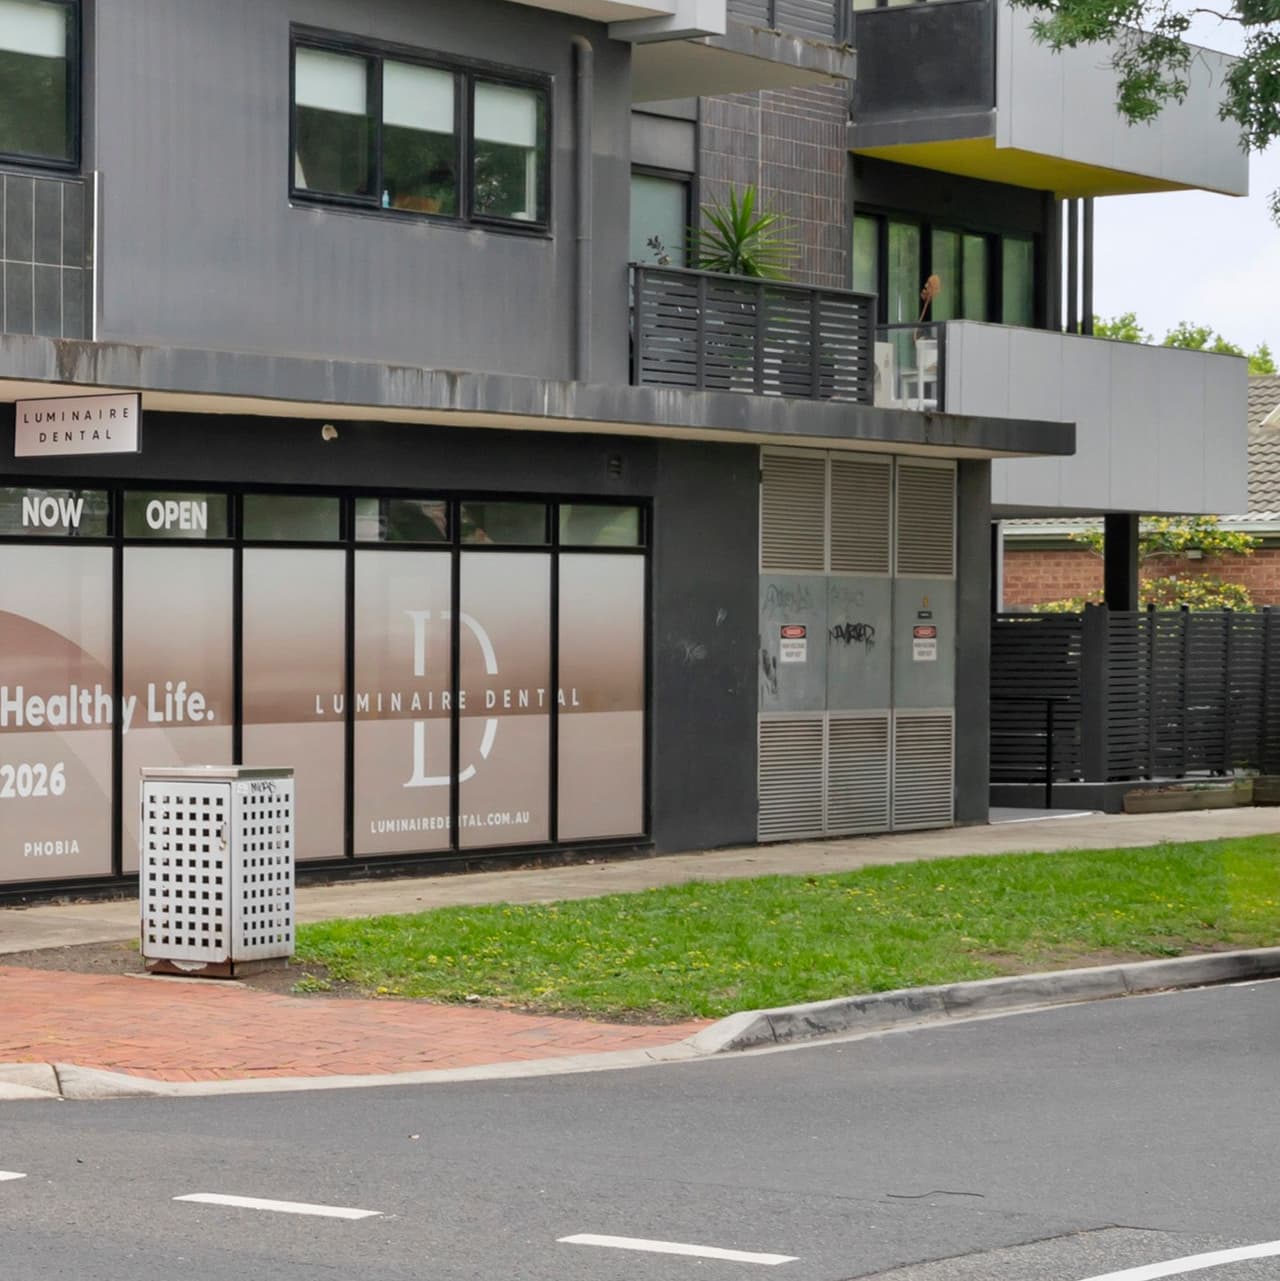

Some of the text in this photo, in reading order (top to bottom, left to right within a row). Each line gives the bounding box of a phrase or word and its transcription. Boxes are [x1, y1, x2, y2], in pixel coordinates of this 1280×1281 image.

[23, 407, 129, 424] LUMINAIRE
[39, 429, 112, 443] DENTAL
[22, 496, 84, 528] NOW
[145, 499, 208, 531] OPEN
[0, 684, 137, 736] Healthy
[147, 680, 215, 723] Life.
[315, 687, 580, 715] LUMINAIRE DENTAL
[0, 762, 66, 798] 2026
[370, 811, 530, 834] LUMINAIREDETAL.COM.AU
[24, 839, 80, 857] PHOBIA
